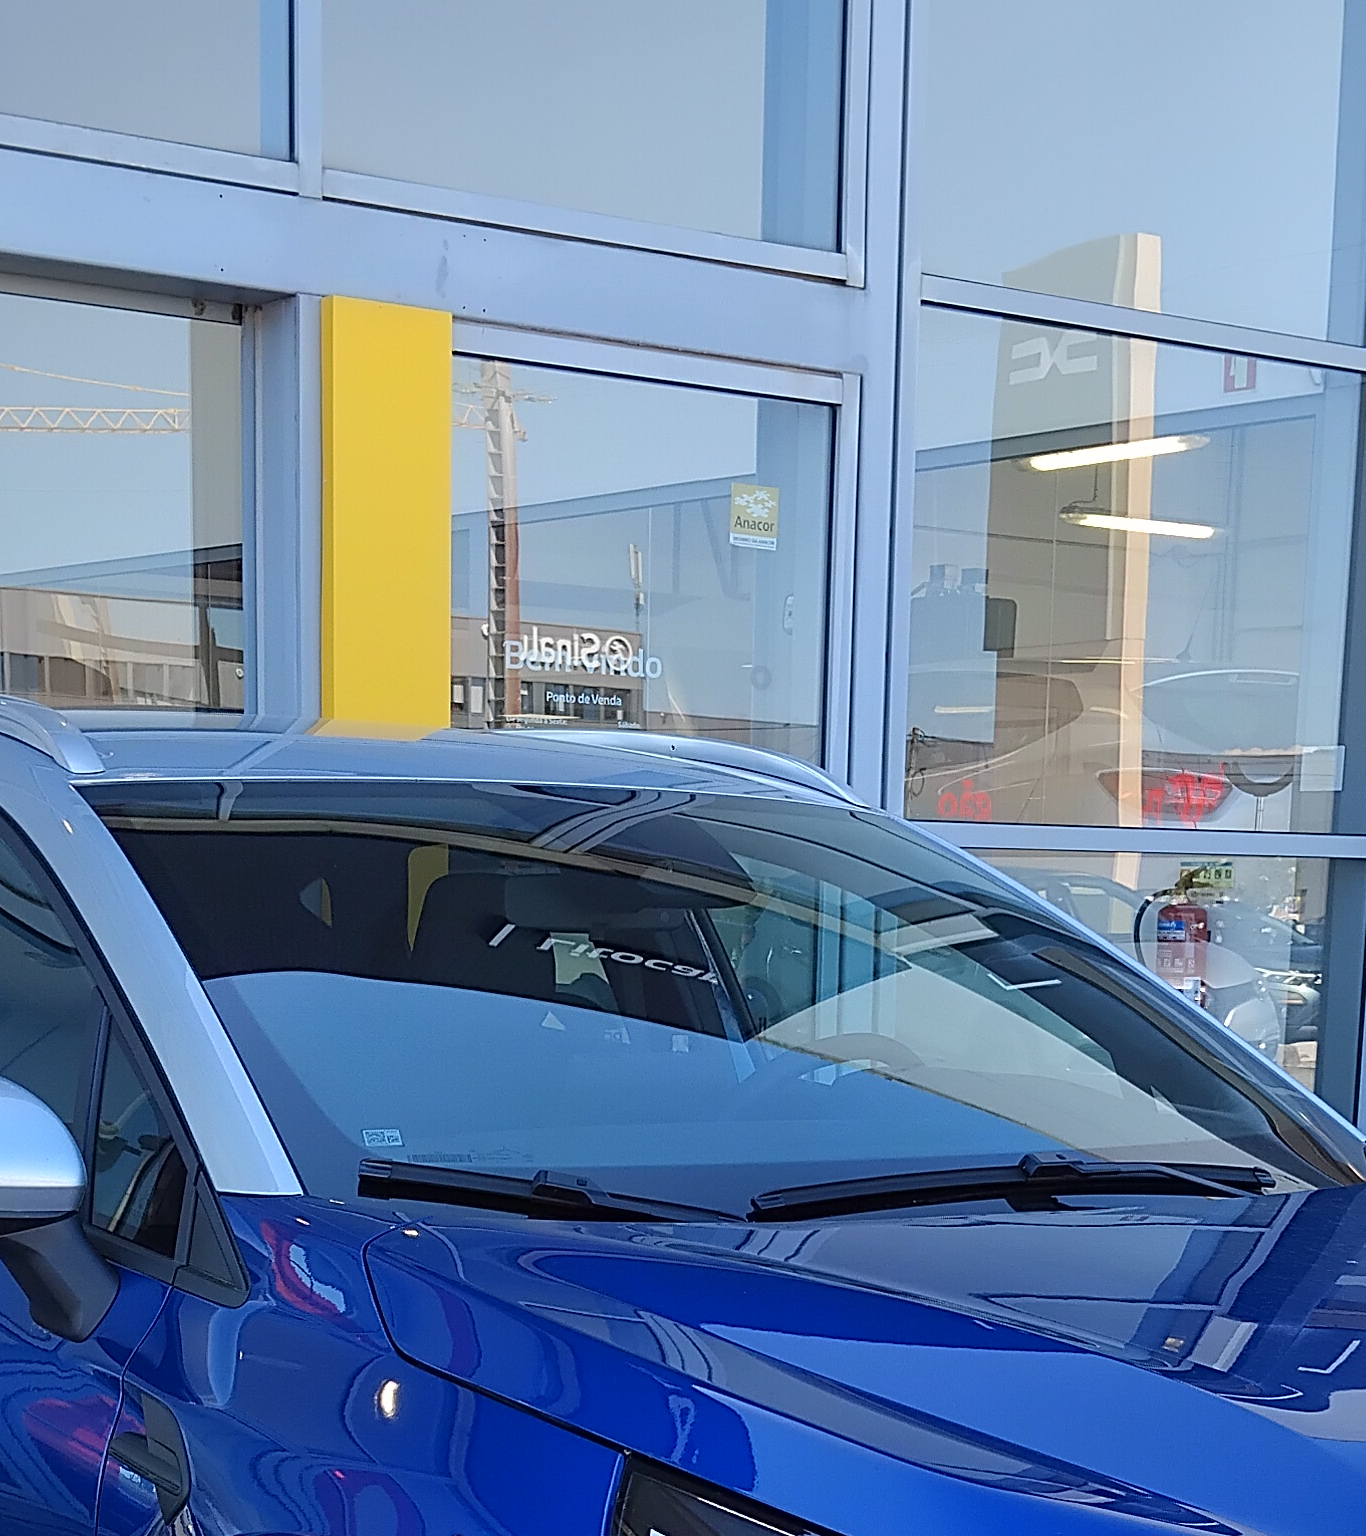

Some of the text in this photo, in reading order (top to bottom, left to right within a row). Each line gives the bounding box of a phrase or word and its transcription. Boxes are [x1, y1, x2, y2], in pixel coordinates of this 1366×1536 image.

[734, 515, 775, 532] Anacor
[546, 691, 622, 706] Ponto de Venda
